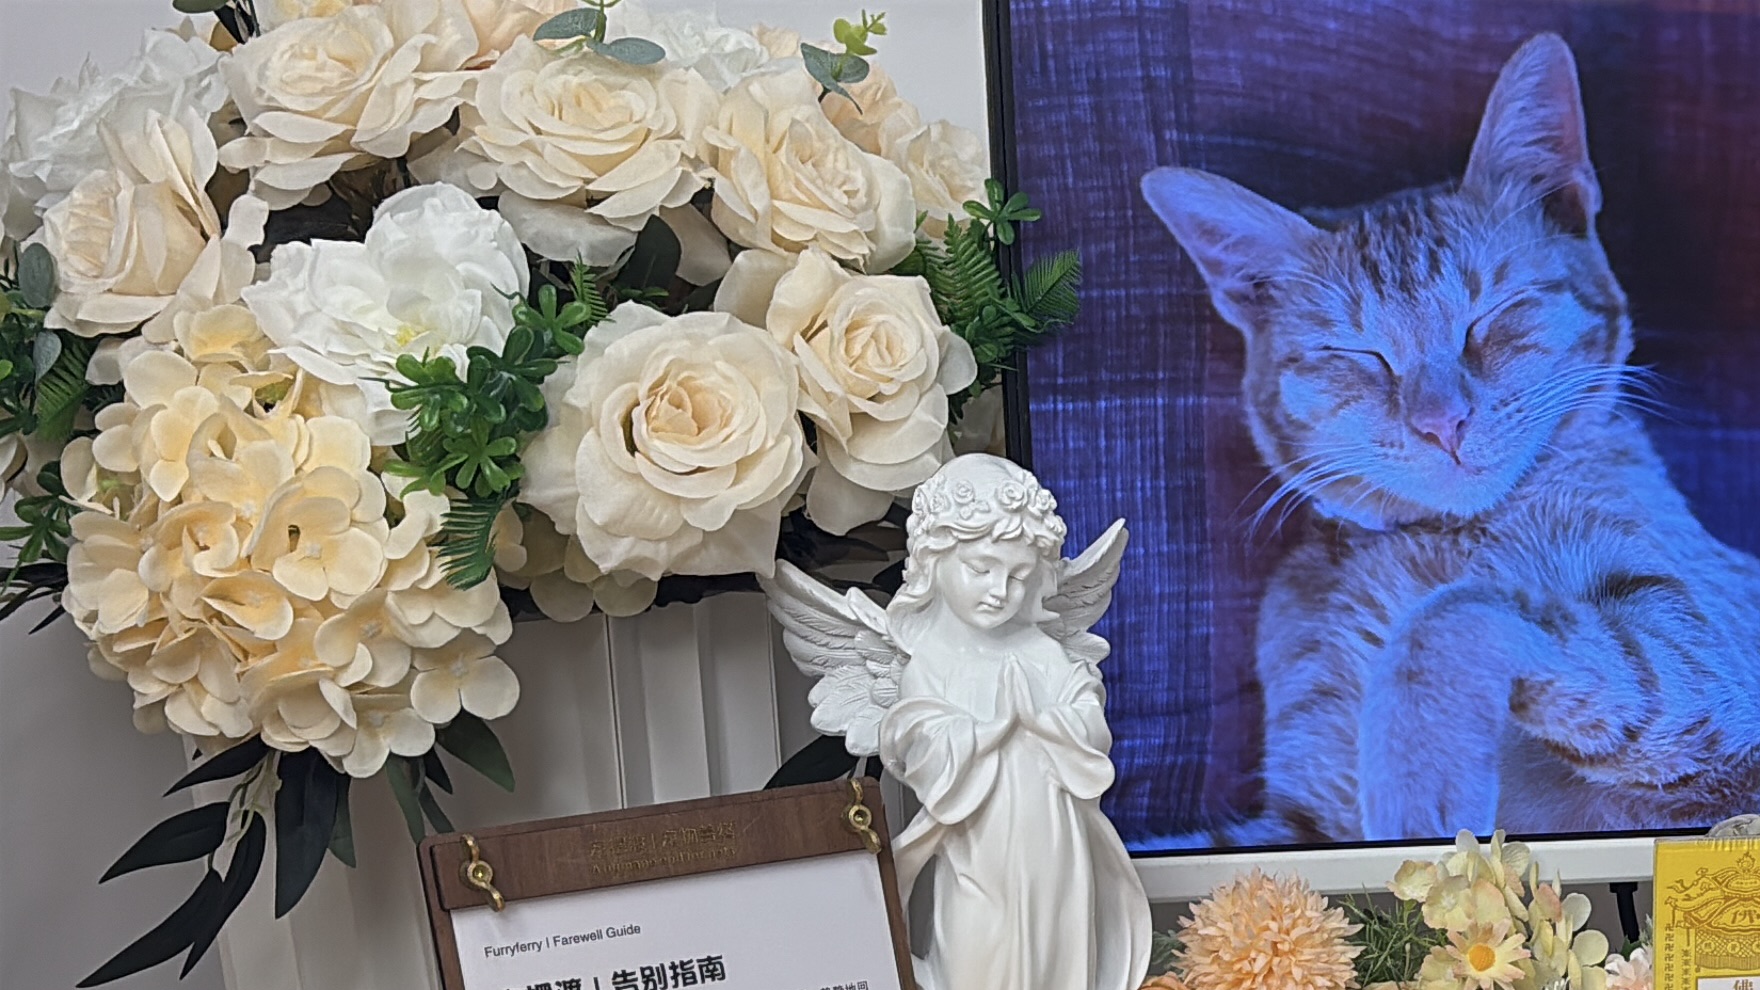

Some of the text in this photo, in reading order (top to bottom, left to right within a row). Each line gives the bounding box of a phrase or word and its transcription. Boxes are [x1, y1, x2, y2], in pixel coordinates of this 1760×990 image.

[484, 940, 543, 958] Furryferry
[553, 928, 603, 947] Farewell
[605, 923, 641, 939] Guide
